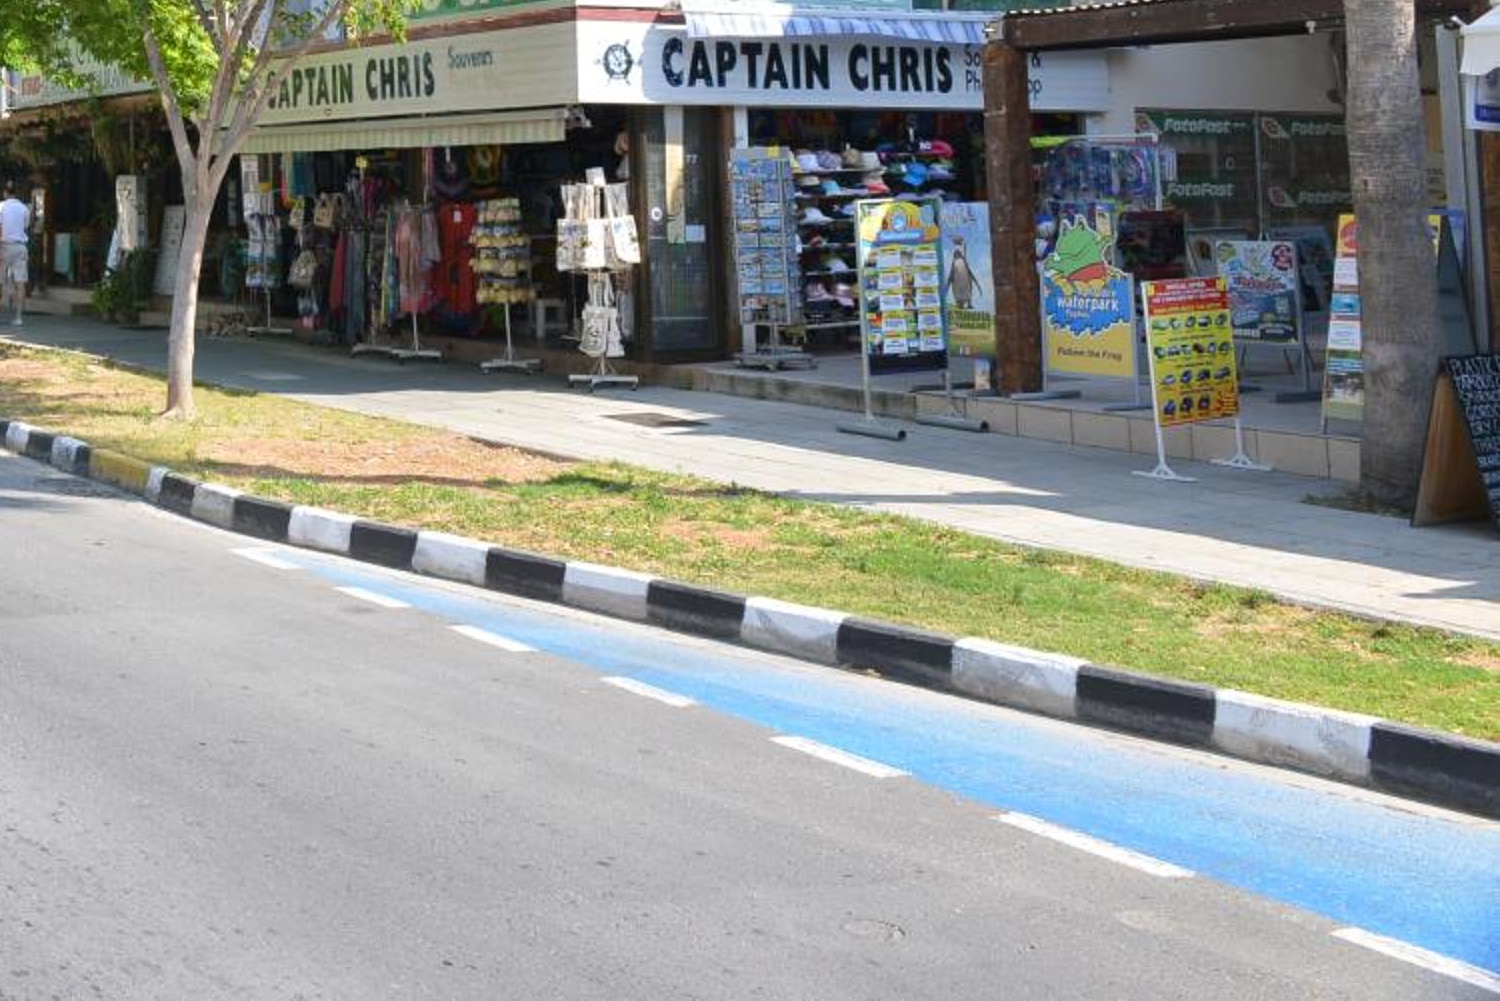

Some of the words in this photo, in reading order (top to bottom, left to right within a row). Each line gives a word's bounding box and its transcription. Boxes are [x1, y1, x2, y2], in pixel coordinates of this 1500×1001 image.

[266, 63, 353, 109] CAPTAIN
[365, 51, 436, 101] CHRIS
[661, 37, 831, 90] CAPTAIN
[847, 43, 954, 94] CHRIS
